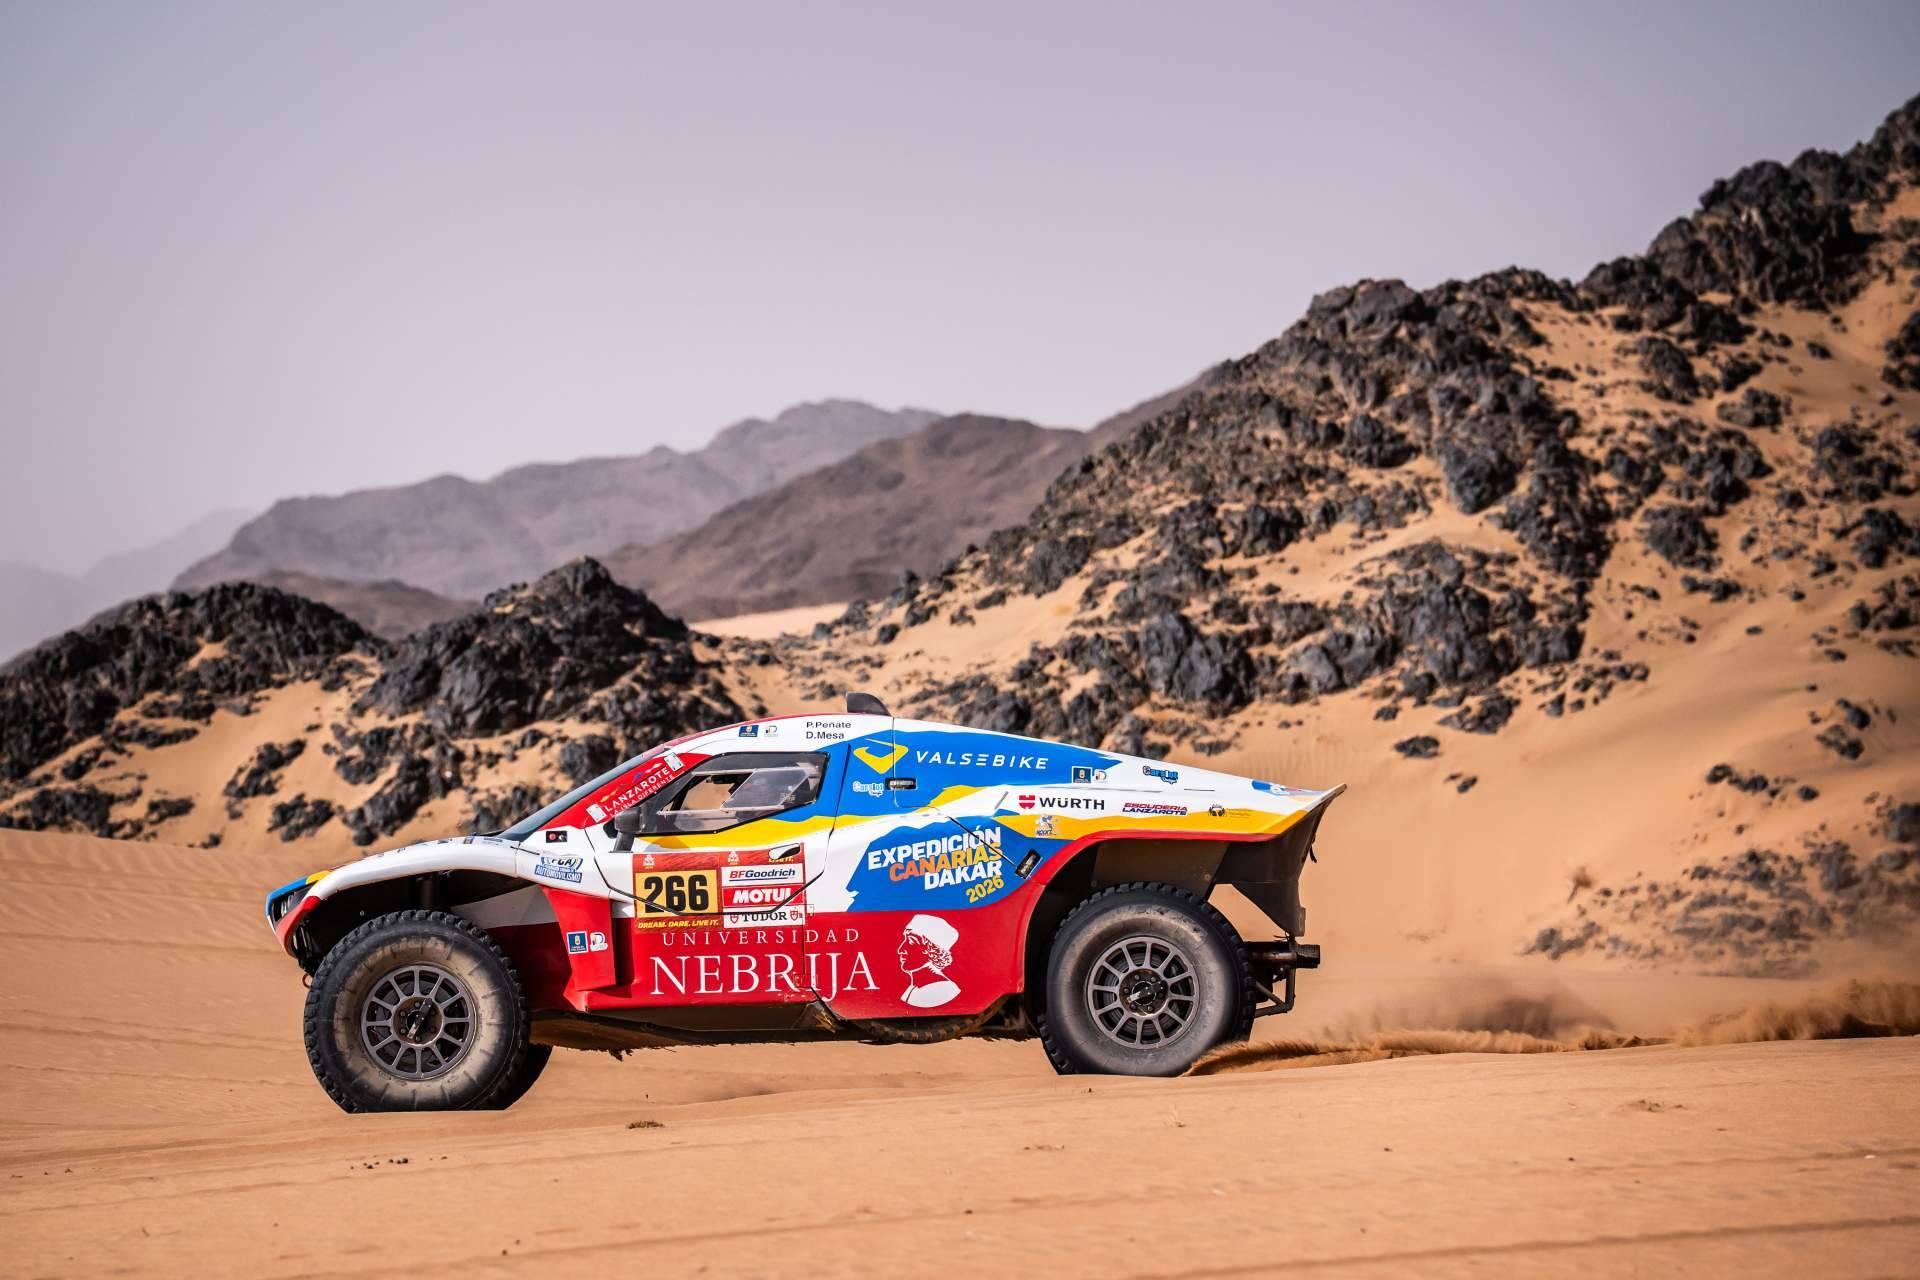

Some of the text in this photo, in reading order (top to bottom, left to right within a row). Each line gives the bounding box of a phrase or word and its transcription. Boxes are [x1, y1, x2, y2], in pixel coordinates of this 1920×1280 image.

[805, 730, 845, 739] D.Mesa
[915, 750, 1049, 770] VALSEBIKE
[604, 766, 671, 812] LANZAROTE
[637, 774, 675, 800] DIFERENTE
[1039, 796, 1105, 811] WÜRTH
[1122, 807, 1187, 816] LANZAROTE
[1124, 802, 1188, 811] ESCUDERIA
[867, 824, 1001, 871] EXPEDICIÓN
[889, 841, 1003, 882] CANARIAS
[729, 868, 796, 879] BFGoodrich
[924, 860, 1002, 890] DAKAR
[644, 874, 709, 914] 266
[965, 875, 1005, 904] 2026
[637, 921, 667, 929] DREAM.
[668, 920, 691, 928] DARE.
[692, 919, 709, 927] LIVE
[741, 911, 787, 922] TUDOR
[662, 928, 860, 946] UNIVERSIDAD
[650, 951, 881, 1002] NEBRIJA
